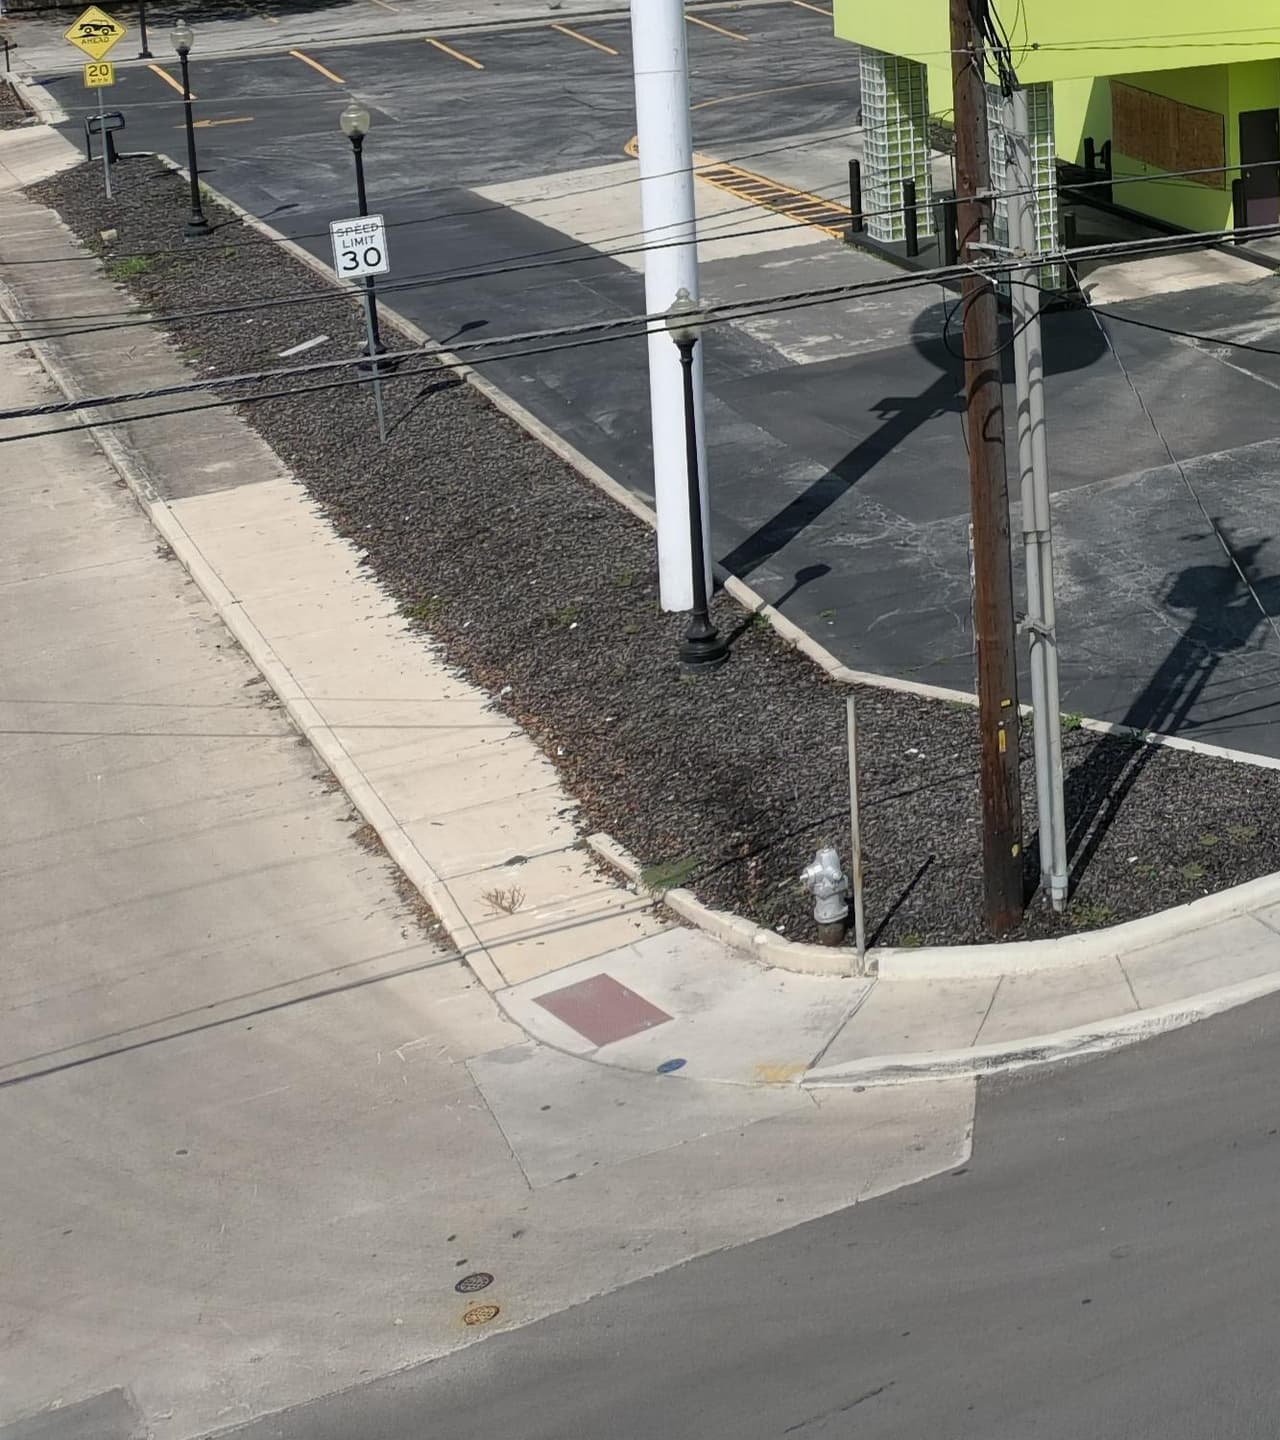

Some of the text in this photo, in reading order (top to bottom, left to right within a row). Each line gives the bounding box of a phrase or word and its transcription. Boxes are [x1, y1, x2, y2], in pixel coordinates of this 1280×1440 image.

[81, 36, 110, 45] AHEAD
[87, 64, 109, 77] 20
[335, 222, 379, 238] SPEED
[342, 234, 376, 249] LIMIT
[341, 246, 382, 271] 30
